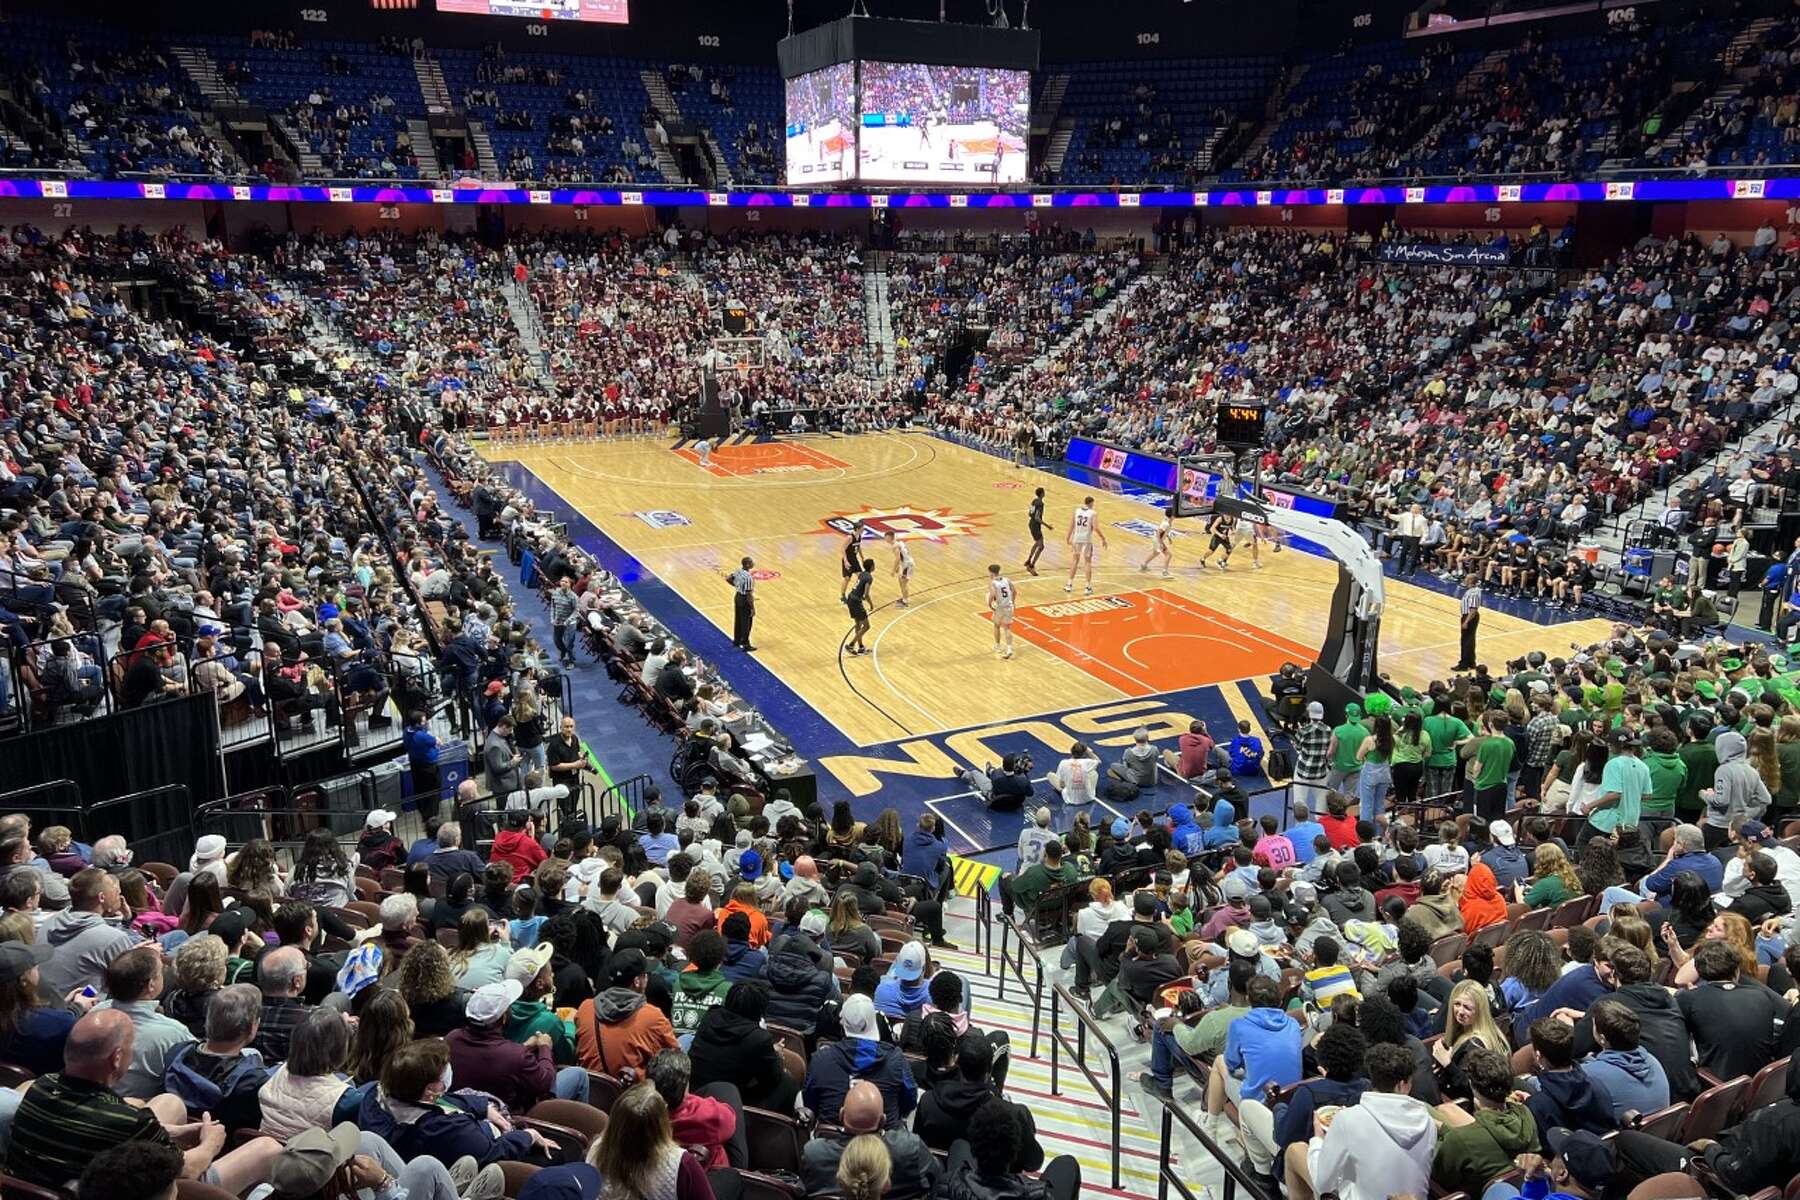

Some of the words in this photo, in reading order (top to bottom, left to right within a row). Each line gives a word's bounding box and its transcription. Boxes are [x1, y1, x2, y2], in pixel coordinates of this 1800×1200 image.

[300, 9, 327, 22] 122
[1353, 14, 1371, 27] 105
[1608, 7, 1635, 25] 106
[526, 25, 548, 35] 101
[698, 35, 720, 47] 102
[1137, 33, 1159, 44] 104
[53, 203, 73, 217] 27
[575, 209, 588, 220] 11
[746, 210, 761, 221] 12
[1484, 207, 1501, 222] 15
[1441, 248, 1464, 262] Sun
[1467, 247, 1506, 263] Arena
[1229, 408, 1257, 420] 4:44
[1077, 515, 1088, 527] 32
[1001, 586, 1008, 598] 5
[1272, 846, 1291, 864] 30
